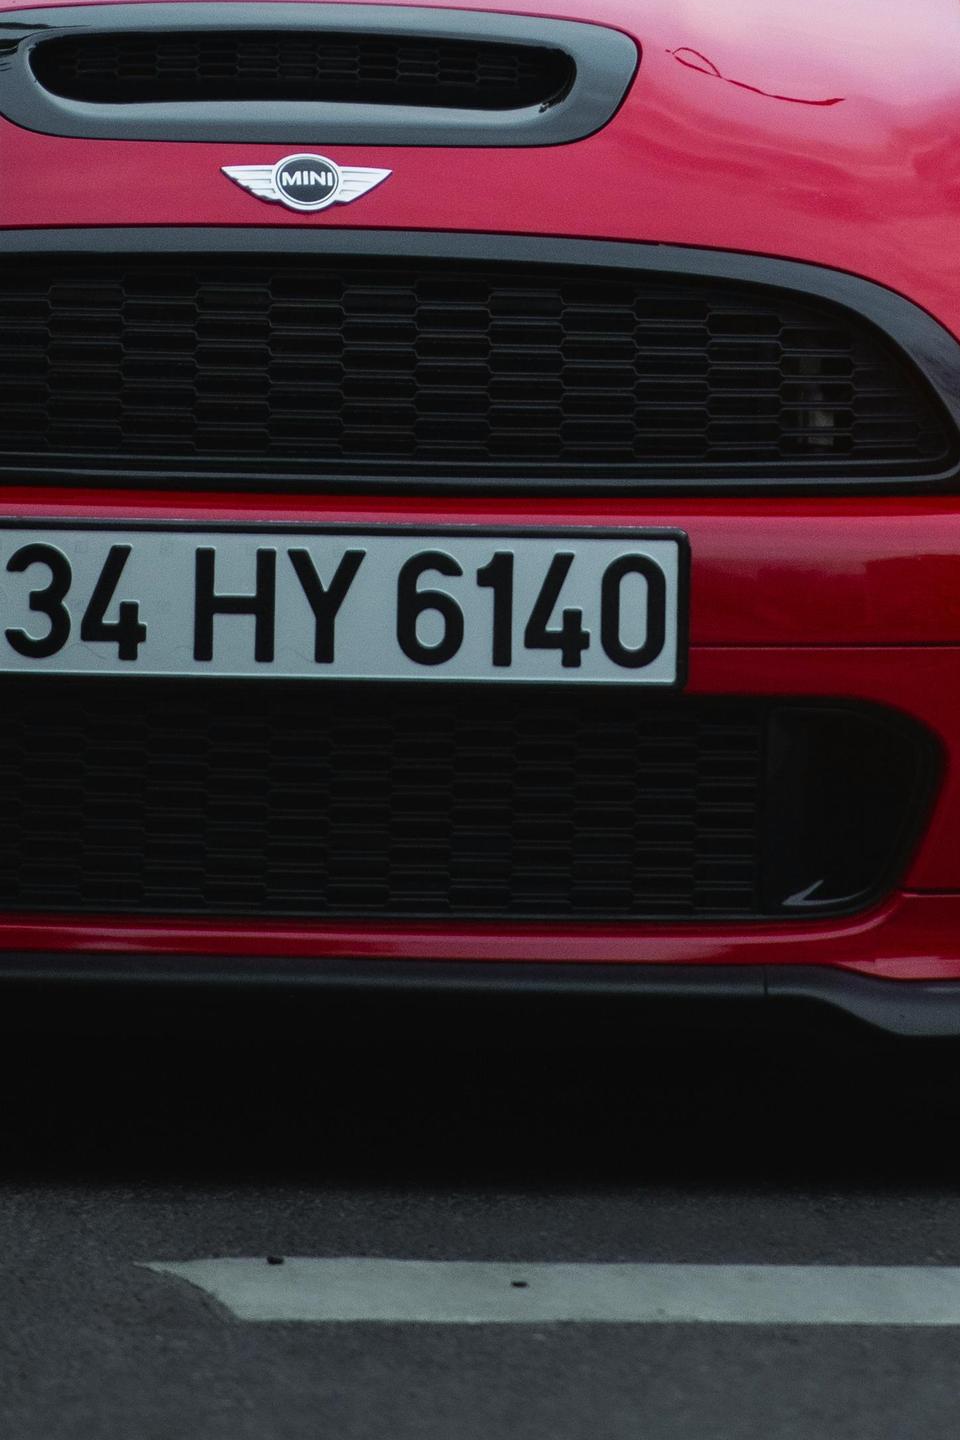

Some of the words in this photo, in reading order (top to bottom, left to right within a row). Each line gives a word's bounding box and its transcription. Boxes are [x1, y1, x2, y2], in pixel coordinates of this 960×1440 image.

[282, 171, 333, 186] MINI
[4, 542, 147, 661] 34
[193, 546, 367, 664] HY
[396, 549, 667, 670] 6140
